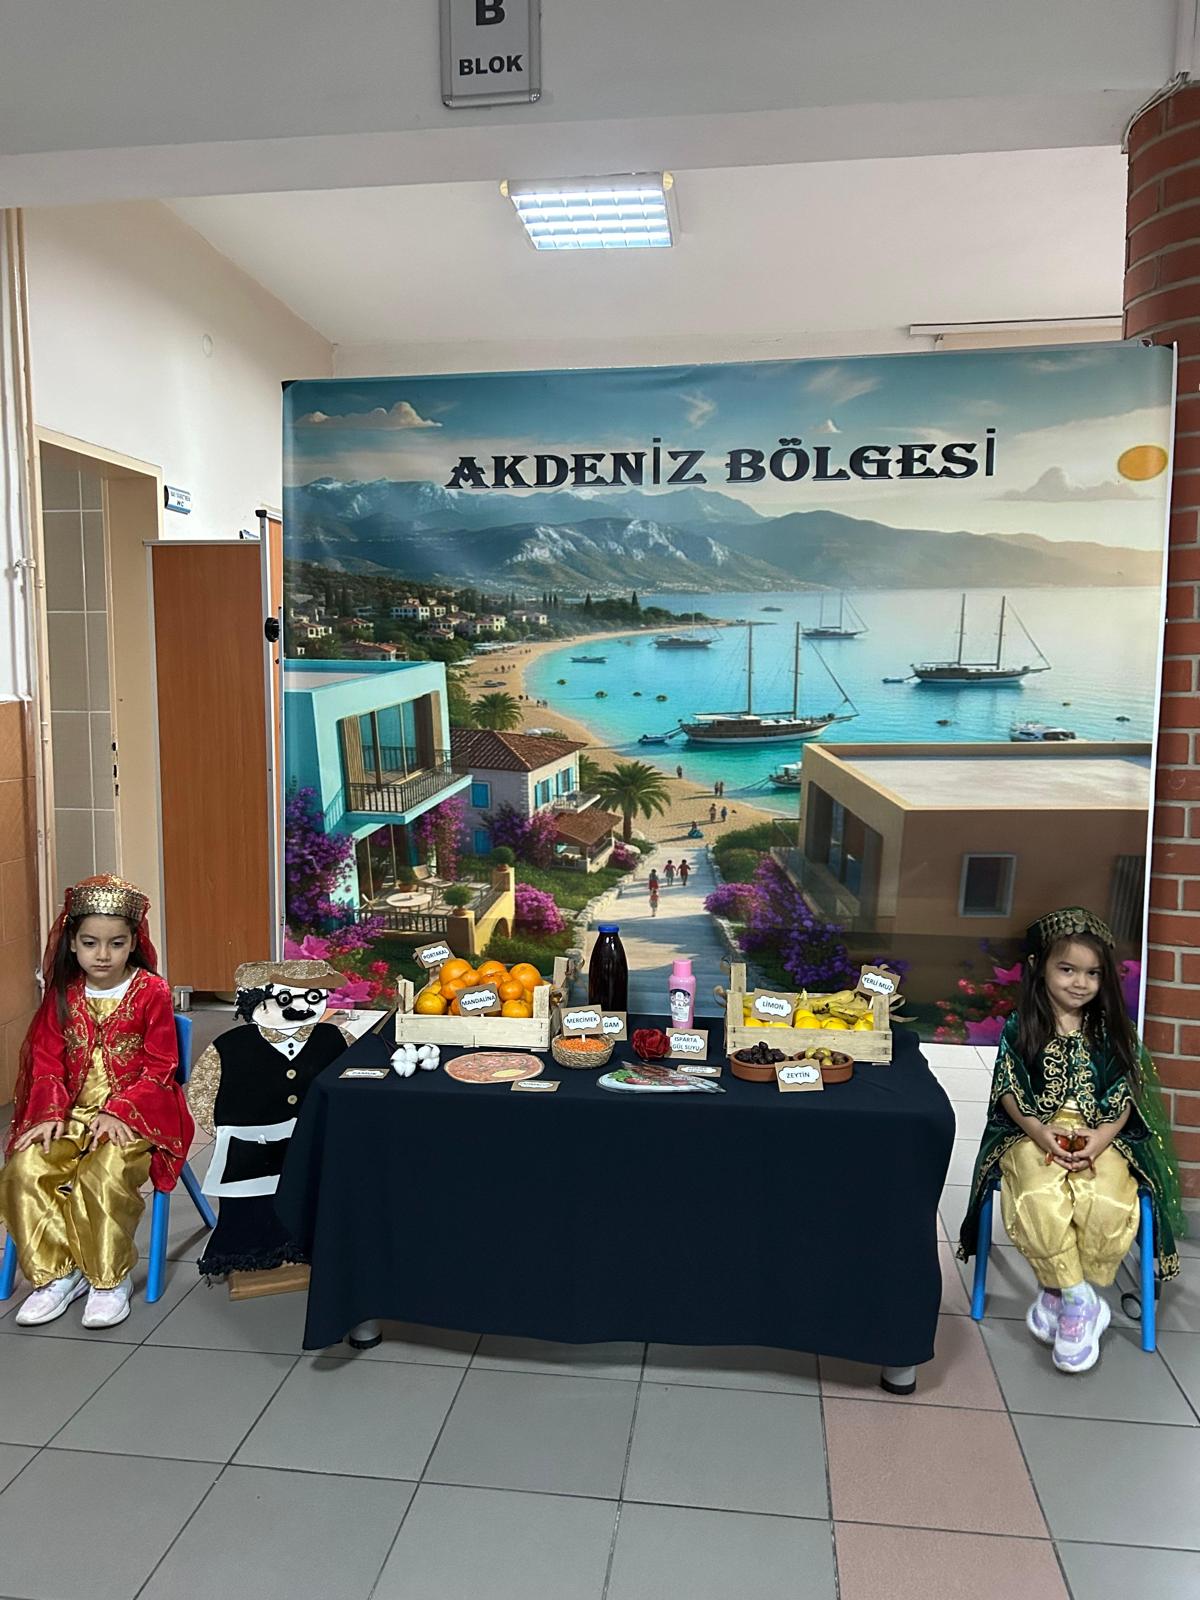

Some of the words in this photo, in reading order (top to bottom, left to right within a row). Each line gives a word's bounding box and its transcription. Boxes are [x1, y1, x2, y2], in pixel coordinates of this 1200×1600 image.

[476, 0, 506, 26] B
[459, 54, 523, 76] BLOK
[444, 437, 707, 489] AKDENİZ
[725, 428, 996, 483] BÖLGESİ
[423, 949, 448, 960] PORTAKAL
[863, 977, 878, 987] YERLİ
[879, 981, 893, 991] MUZ
[461, 995, 496, 1006] MANDALİNA
[762, 1001, 784, 1010] LİMON
[566, 1016, 598, 1024] MERCİMEK
[786, 1071, 810, 1079] ZEYTİN
